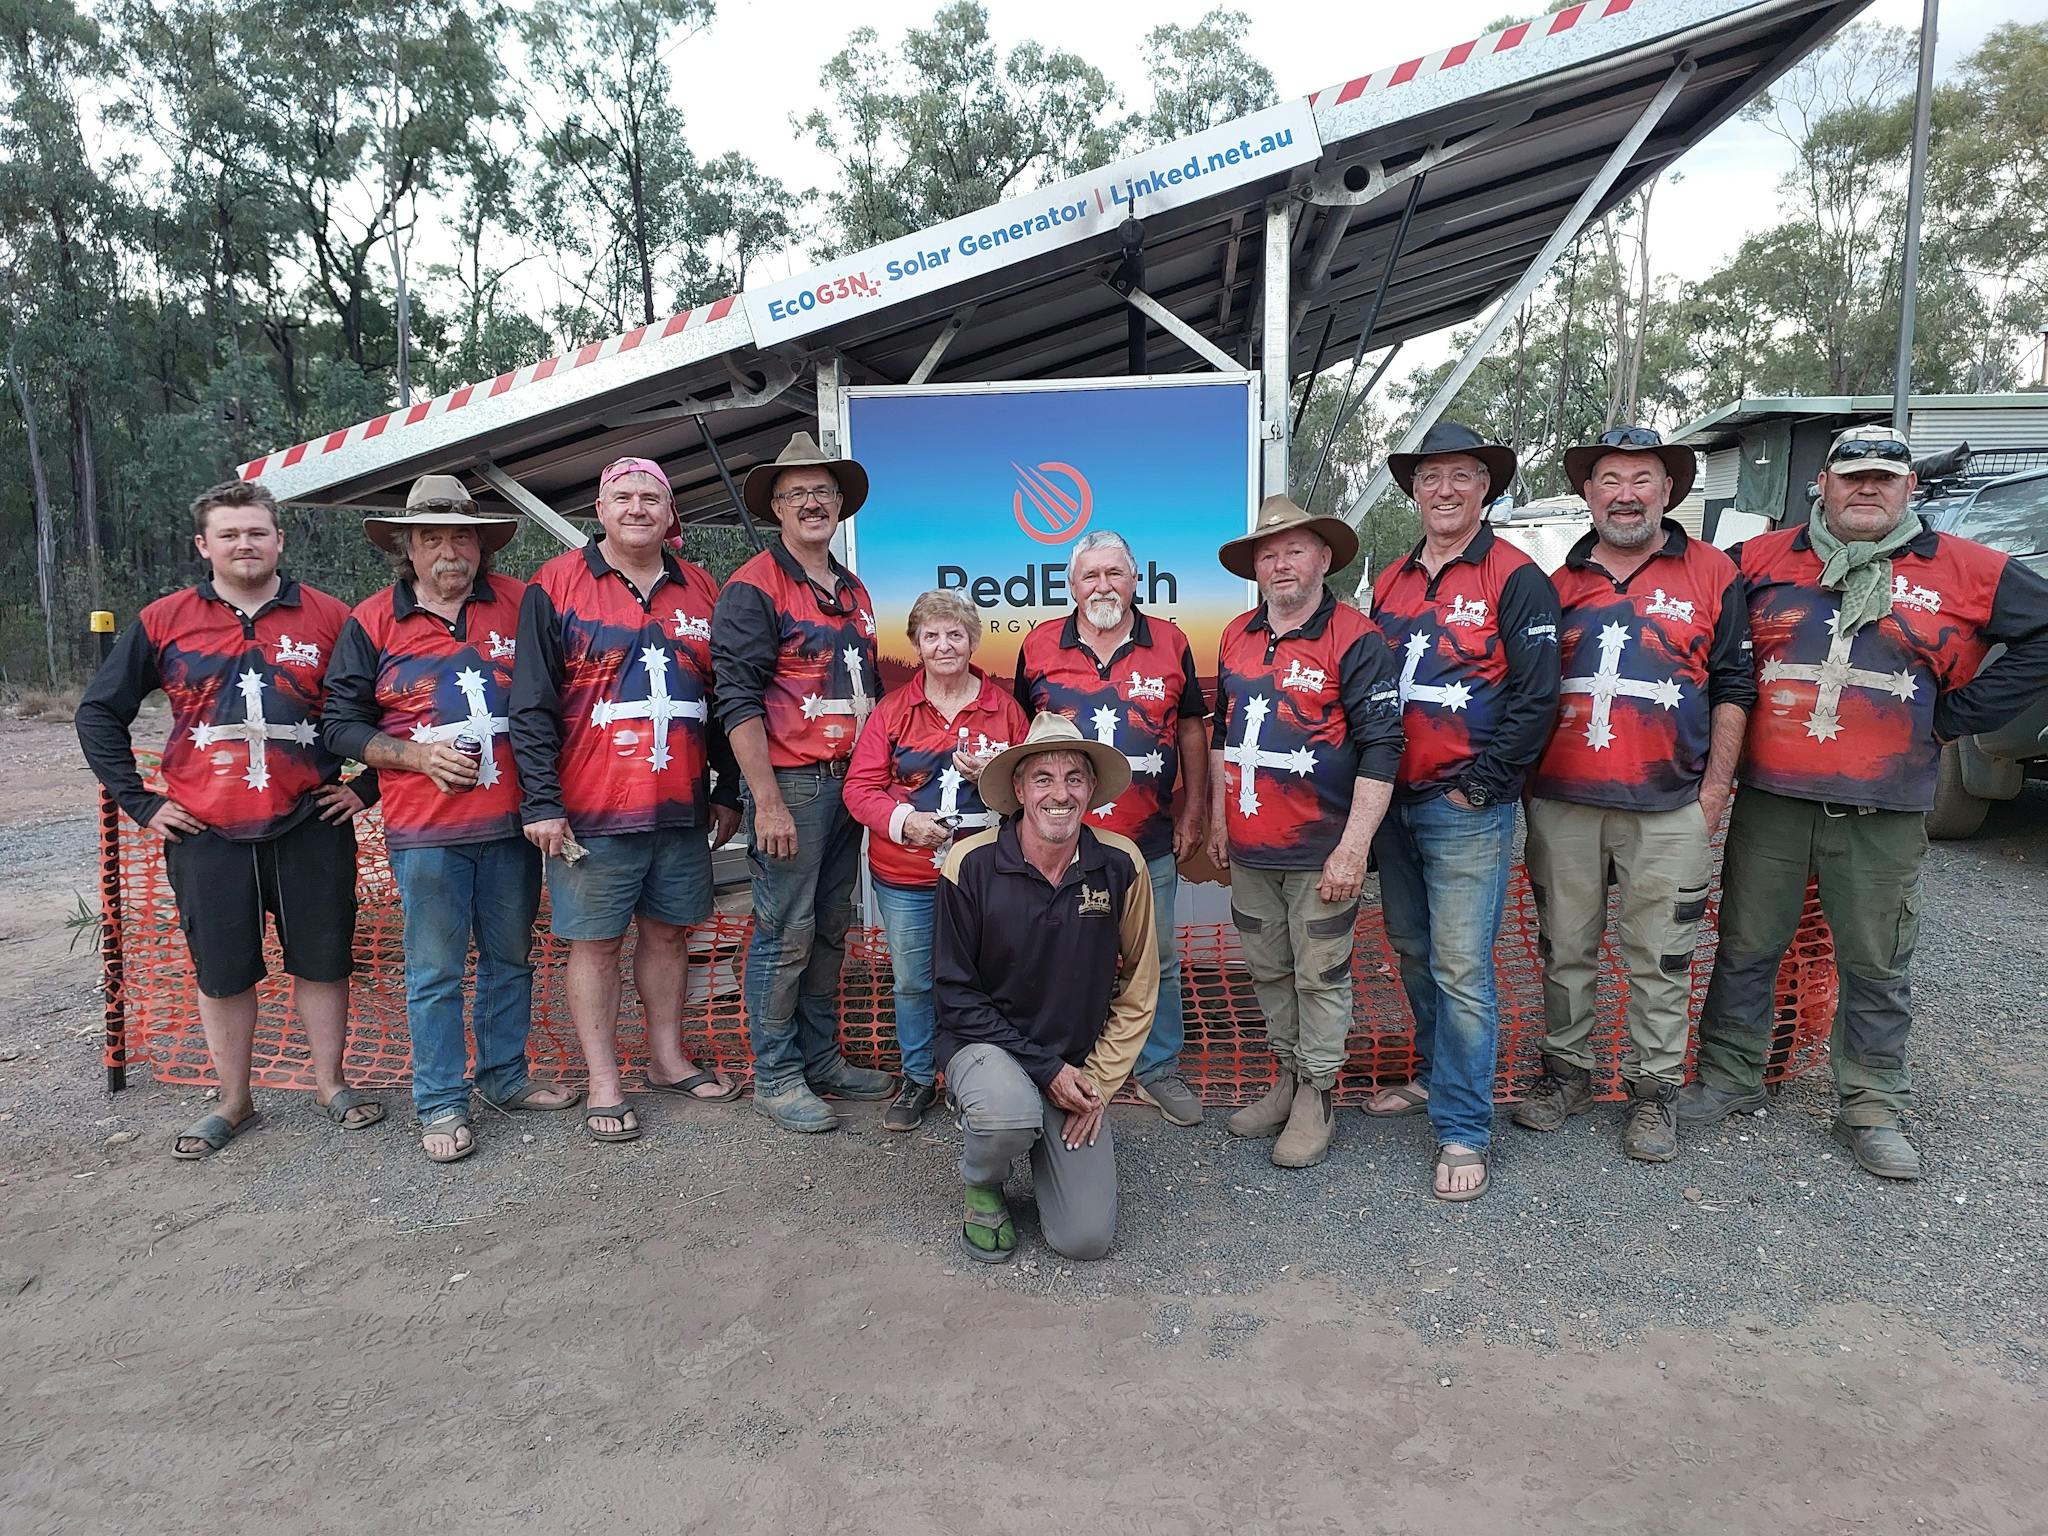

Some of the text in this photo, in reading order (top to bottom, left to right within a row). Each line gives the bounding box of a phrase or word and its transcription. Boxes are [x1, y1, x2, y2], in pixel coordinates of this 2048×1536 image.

[886, 246, 950, 281] Solar
[958, 199, 1088, 256] Generator
[1110, 128, 1294, 205] Linked.net.au
[937, 561, 1177, 608] RedEth
